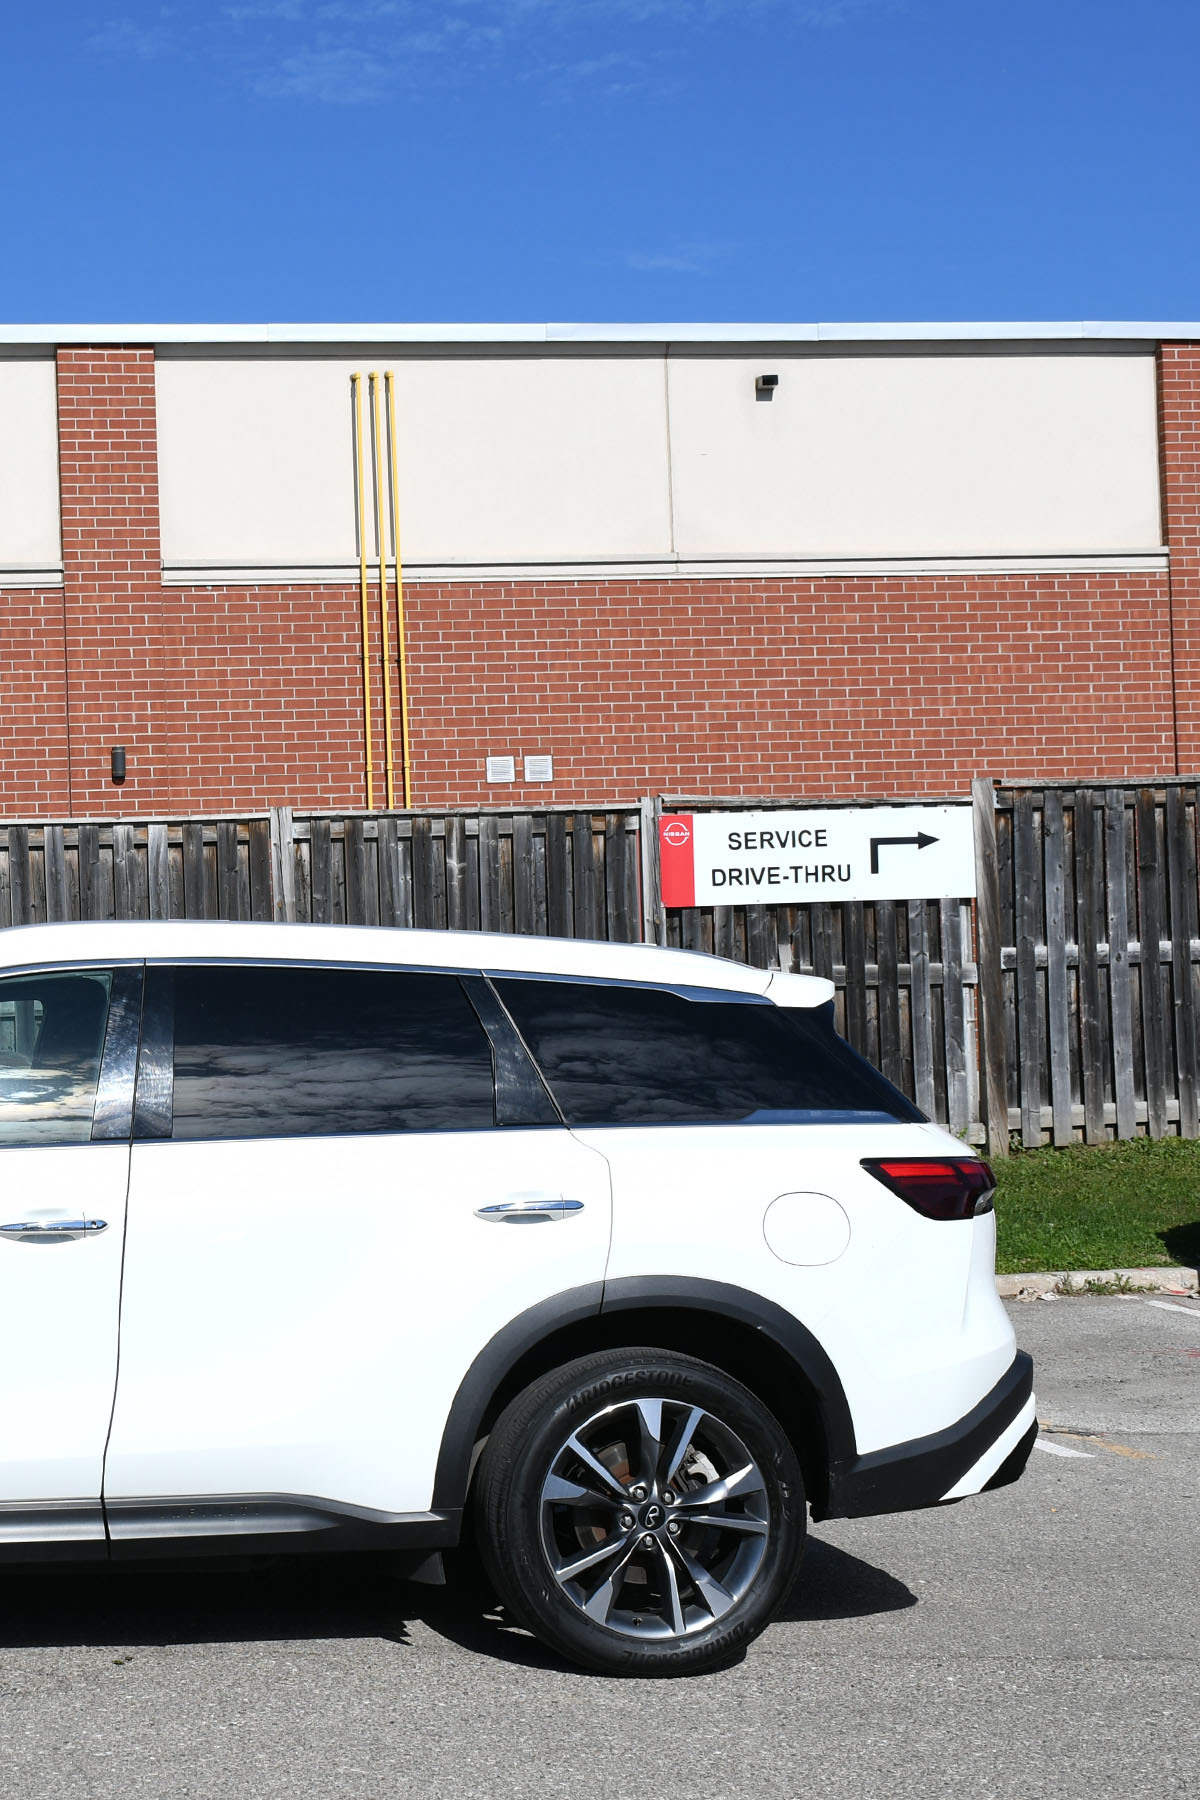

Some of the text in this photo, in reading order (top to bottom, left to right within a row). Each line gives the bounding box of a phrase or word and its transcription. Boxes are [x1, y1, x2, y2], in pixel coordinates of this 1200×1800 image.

[728, 829, 828, 850] SERVICE
[711, 864, 852, 887] DRIVE-THRU
[564, 1370, 694, 1416] BRIDGESTONE
